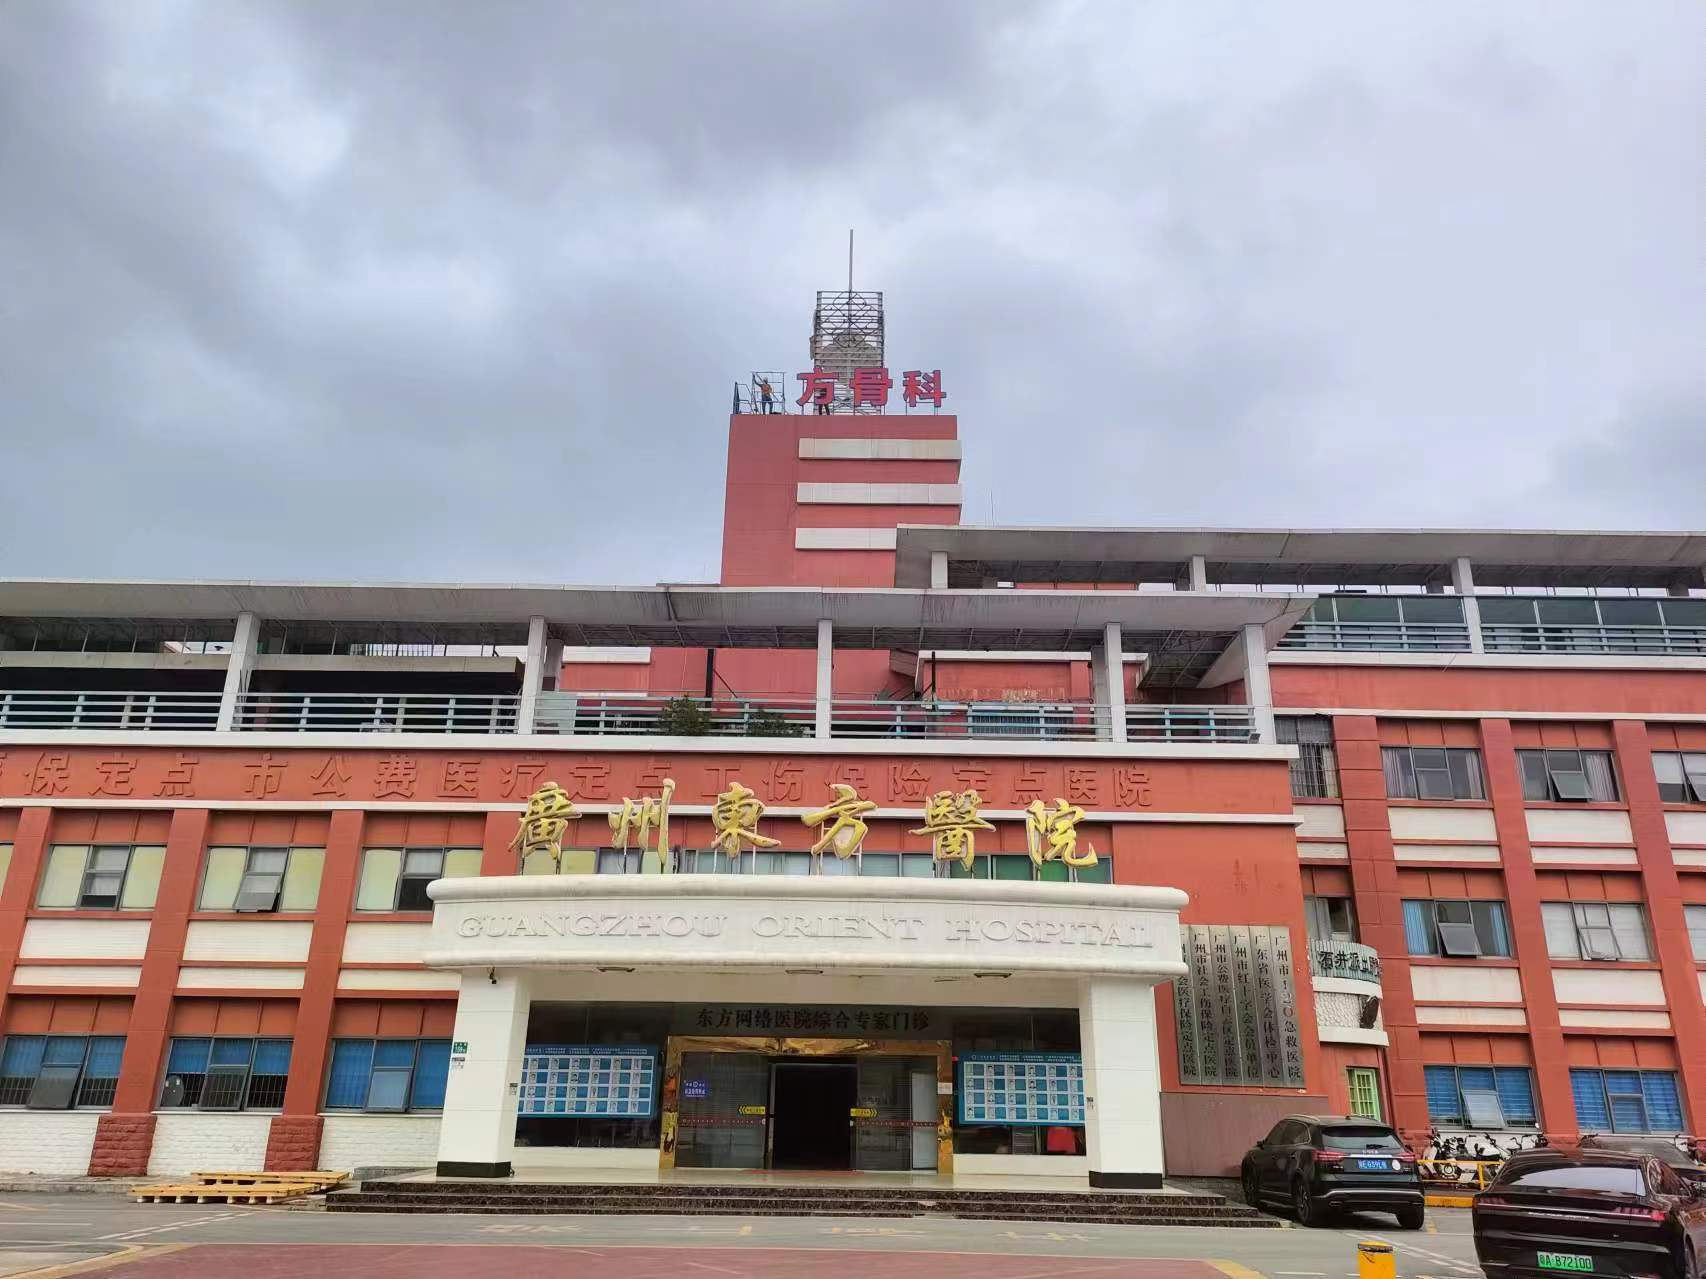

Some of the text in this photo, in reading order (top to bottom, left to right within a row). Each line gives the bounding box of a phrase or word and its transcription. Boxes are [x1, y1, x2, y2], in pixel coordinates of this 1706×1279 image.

[796, 367, 947, 408] 方骨科
[0, 751, 200, 798] 保定点
[456, 911, 1153, 948] GUANGZHOU ORIENT HOSPITAL
